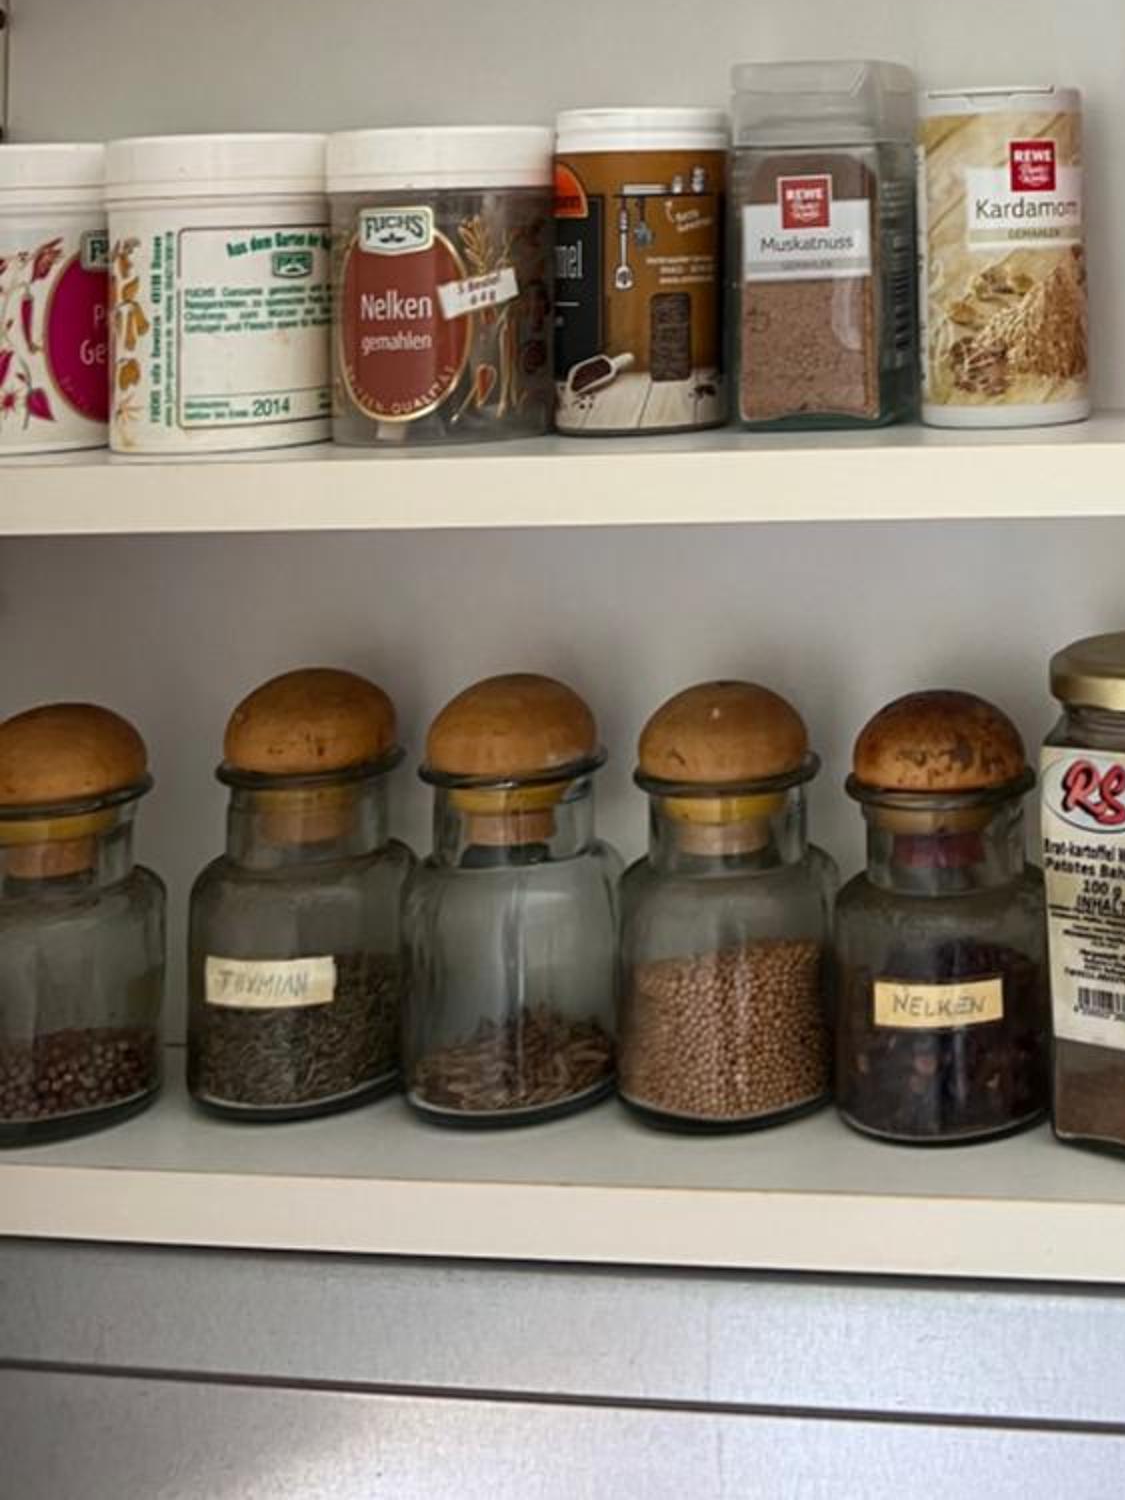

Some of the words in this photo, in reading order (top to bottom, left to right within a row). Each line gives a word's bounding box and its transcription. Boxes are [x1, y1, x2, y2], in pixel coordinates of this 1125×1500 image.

[1013, 149, 1052, 162] REWE
[365, 213, 424, 240] FUCHS
[760, 236, 854, 253] Muskatnuss
[360, 290, 433, 321] Nelken
[79, 339, 108, 366] Ge
[360, 330, 433, 356] gemahlen
[252, 397, 290, 417] 2014
[1045, 857, 1097, 876] Patates
[1083, 880, 1110, 895] 100
[1112, 886, 1123, 901] g
[892, 993, 986, 1017] NELKEN
